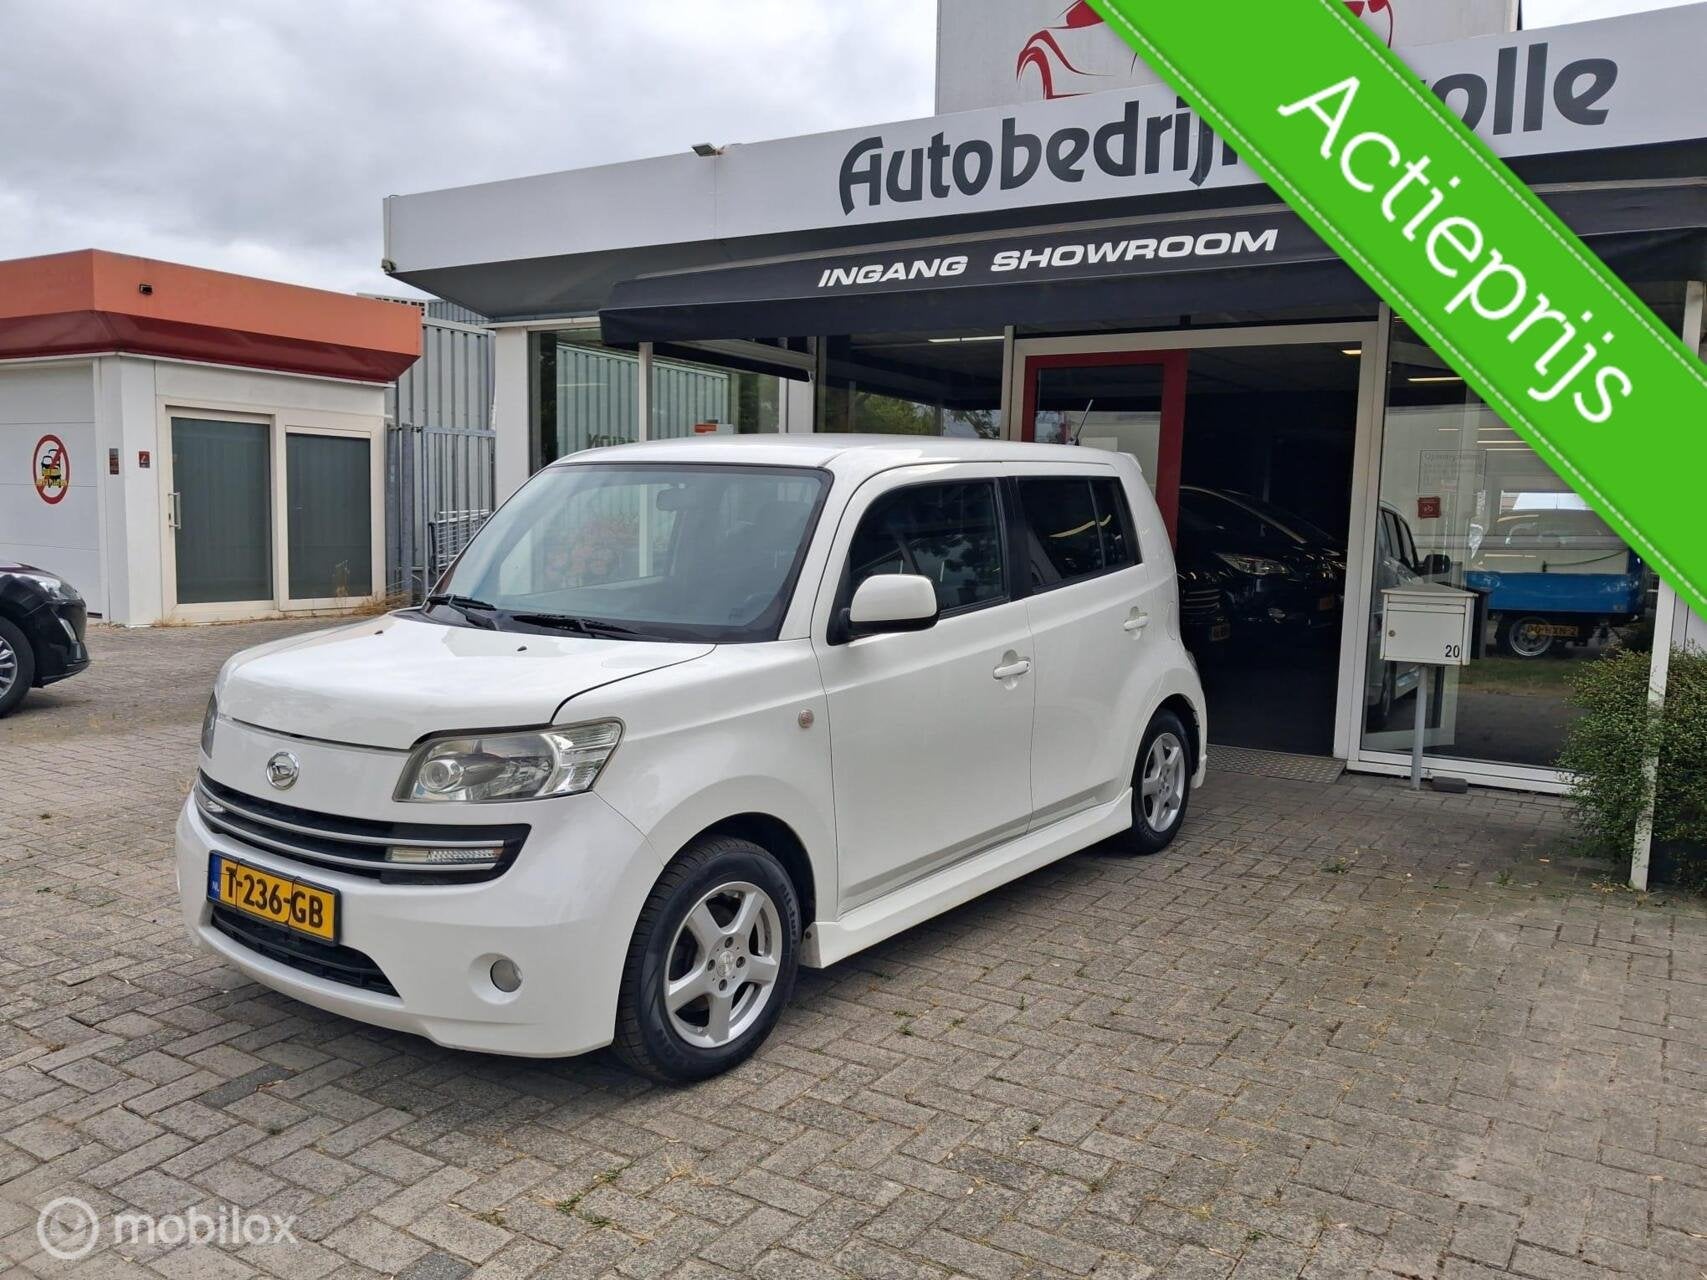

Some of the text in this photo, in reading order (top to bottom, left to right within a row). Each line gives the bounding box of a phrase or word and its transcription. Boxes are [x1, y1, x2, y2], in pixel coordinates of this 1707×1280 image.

[1420, 42, 1618, 136] olle
[817, 229, 1279, 288] INGANG SHOWROOM
[1444, 644, 1461, 658] 20
[225, 865, 324, 929] T-236-GB
